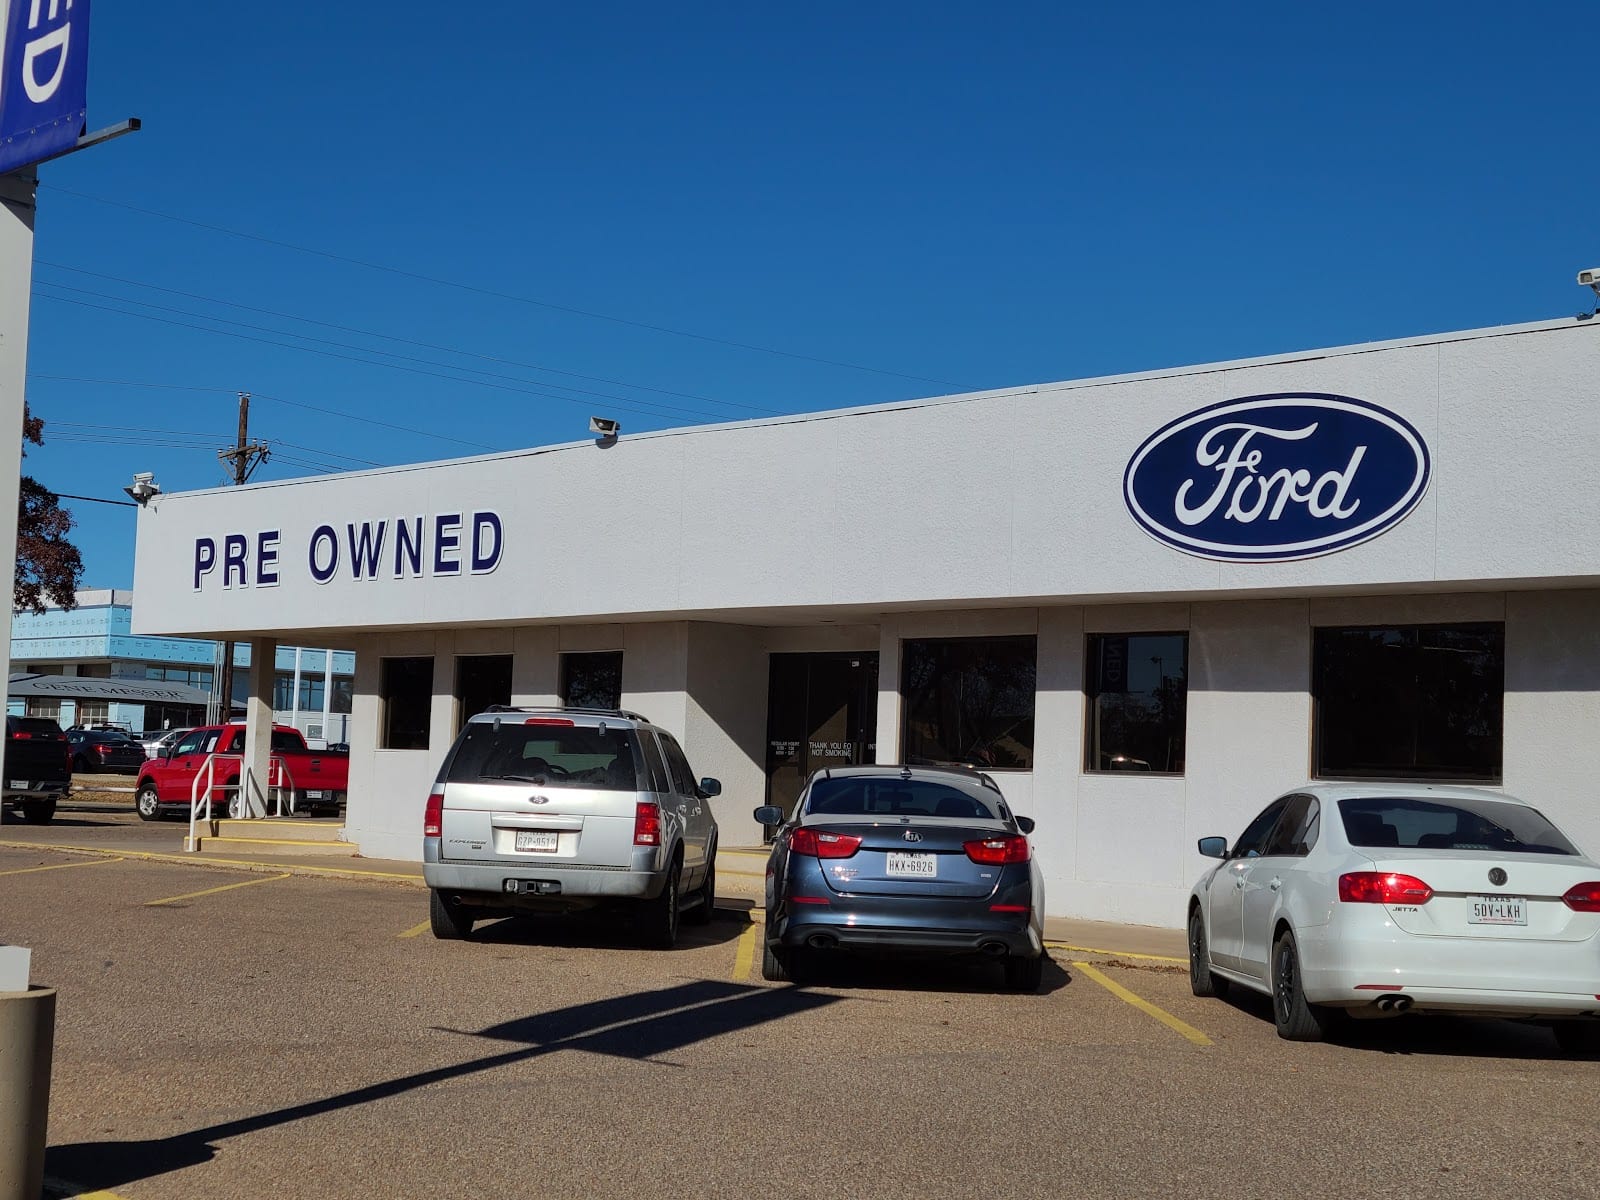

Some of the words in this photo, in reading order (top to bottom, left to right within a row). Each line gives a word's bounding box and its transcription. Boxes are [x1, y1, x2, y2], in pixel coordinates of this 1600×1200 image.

[1175, 422, 1368, 526] Ford
[193, 529, 281, 592] PRE
[308, 510, 504, 584] OWNED
[32, 682, 97, 694] GENE
[101, 687, 187, 698] MESSER
[809, 741, 828, 749] THANK
[811, 749, 823, 757] NOT
[825, 749, 852, 757] SMOKING
